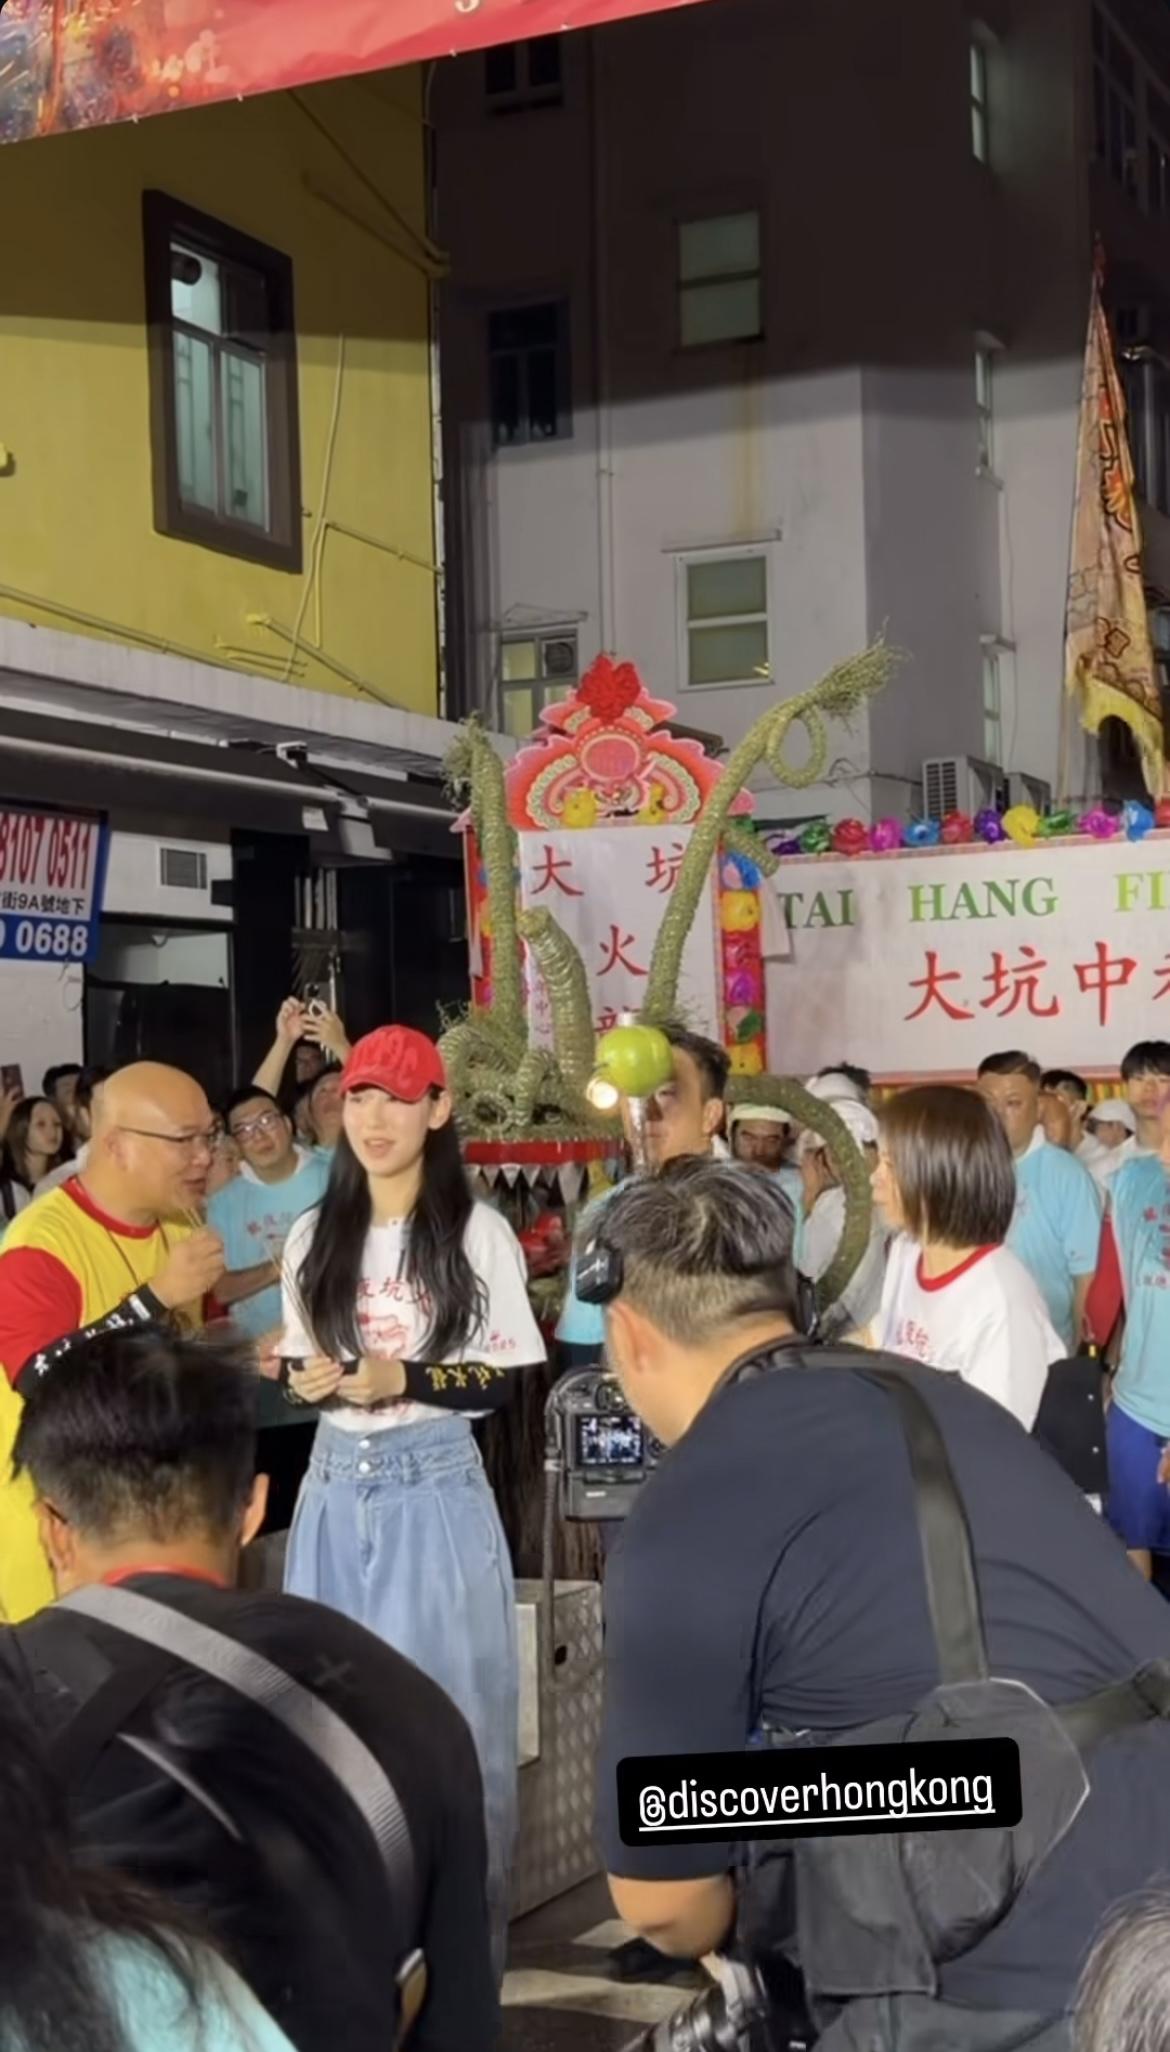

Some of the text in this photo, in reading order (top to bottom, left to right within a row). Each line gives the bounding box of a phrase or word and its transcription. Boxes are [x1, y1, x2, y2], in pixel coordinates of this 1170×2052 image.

[47, 818, 92, 890] 0511
[530, 846, 583, 896] 大
[0, 890, 86, 915] 街9A號地下
[776, 870, 1170, 929] TAI HANG FI
[15, 919, 88, 957] 0688
[596, 925, 648, 977] 火
[904, 941, 1170, 1026] 大坑中
